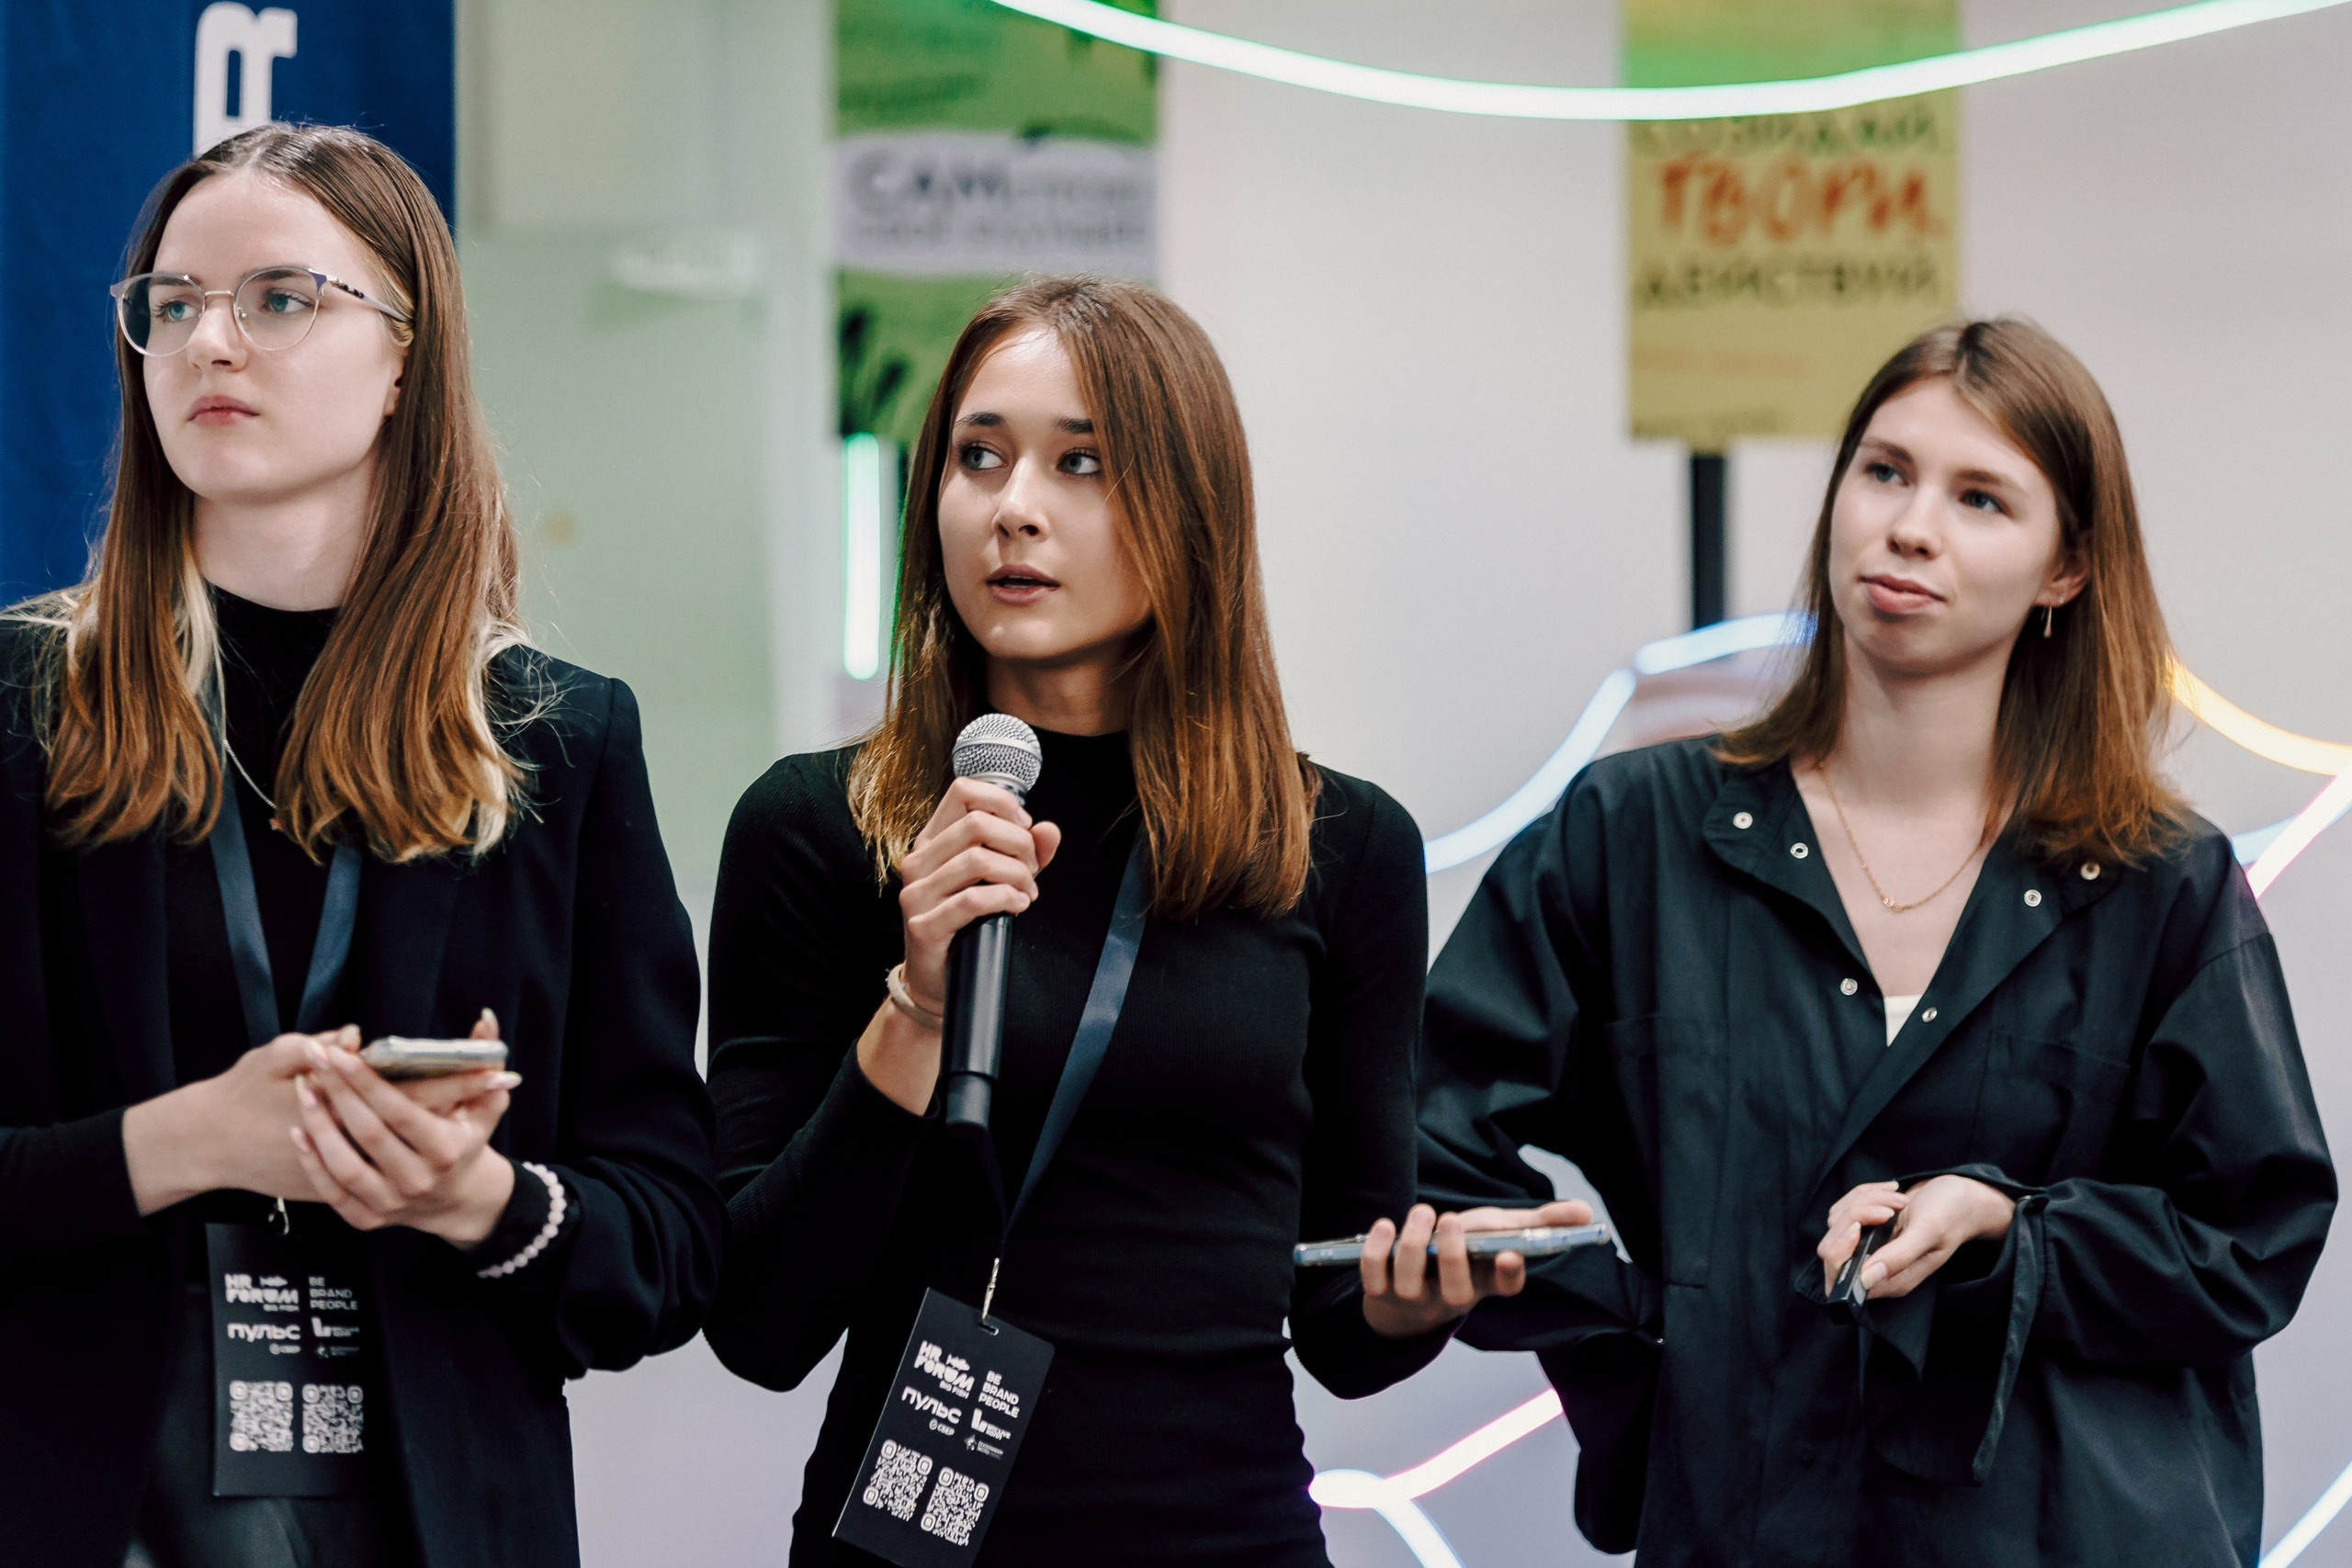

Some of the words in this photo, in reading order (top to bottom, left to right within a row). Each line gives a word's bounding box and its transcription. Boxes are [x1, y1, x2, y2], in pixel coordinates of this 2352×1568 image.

[310, 1288, 353, 1298] BRAND
[310, 1300, 358, 1311] PEOPLE
[918, 1339, 943, 1363] HR
[914, 1354, 976, 1393] FORUM
[986, 1370, 1002, 1386] BE
[978, 1392, 1020, 1418] PEOPLE
[982, 1381, 1019, 1405] BRAND
